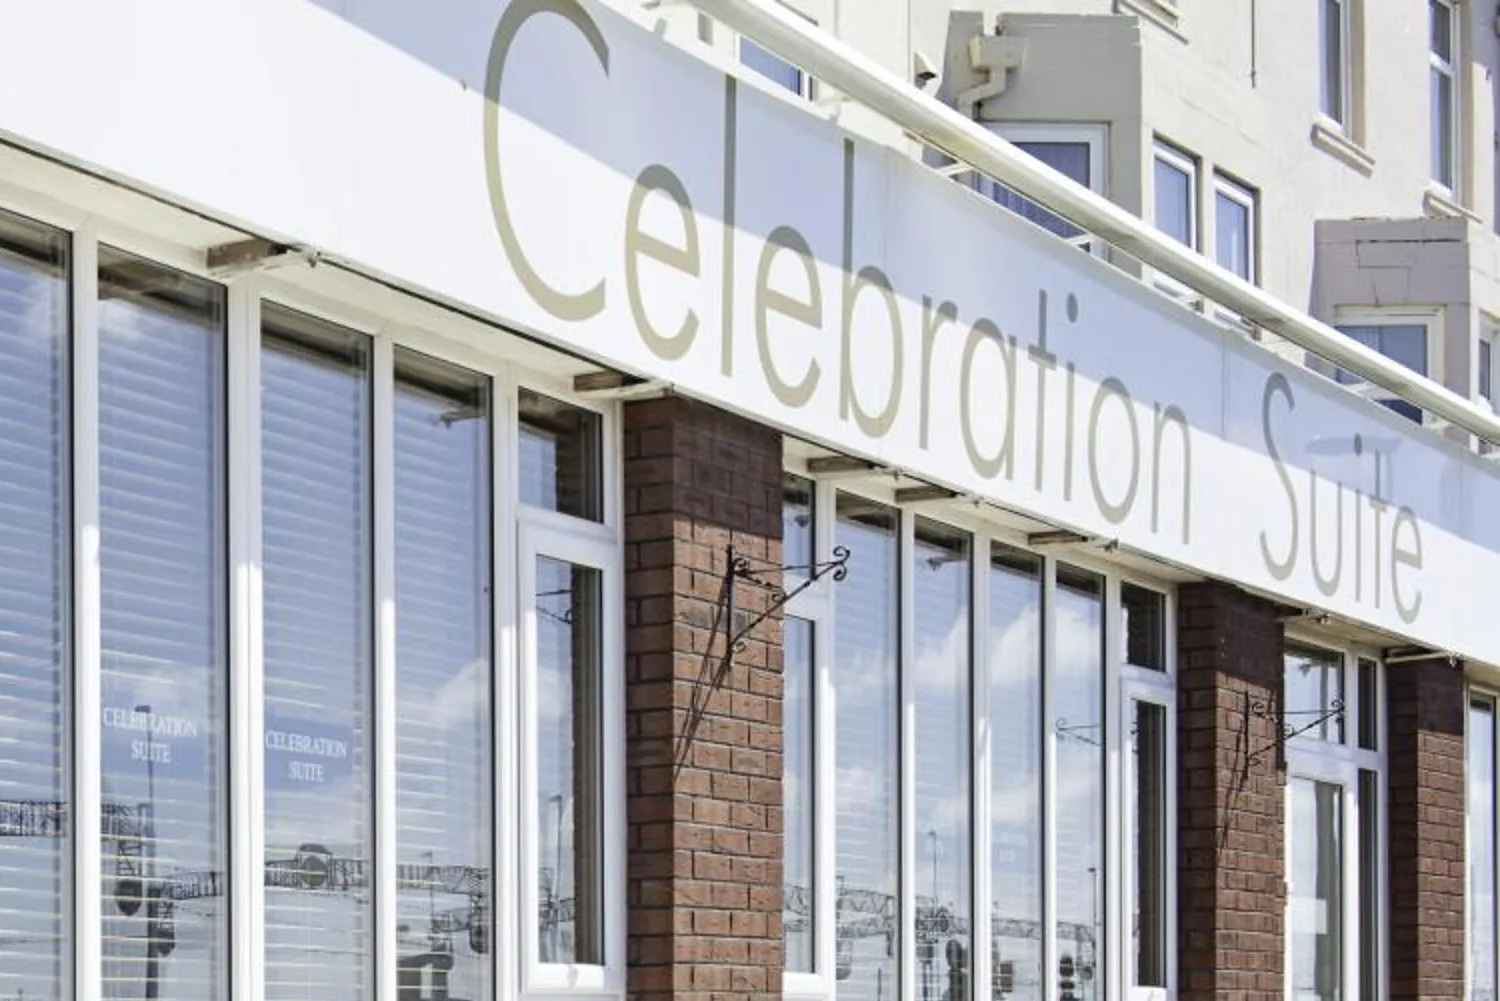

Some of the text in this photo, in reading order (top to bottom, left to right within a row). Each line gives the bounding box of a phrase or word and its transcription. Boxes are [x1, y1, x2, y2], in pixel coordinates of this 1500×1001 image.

[483, 0, 1423, 625] Celebration Suite
[103, 705, 197, 737] CELEBRATION
[131, 740, 172, 764] SUITE
[265, 729, 348, 758] CELEBRATION
[289, 761, 325, 783] SUITE
